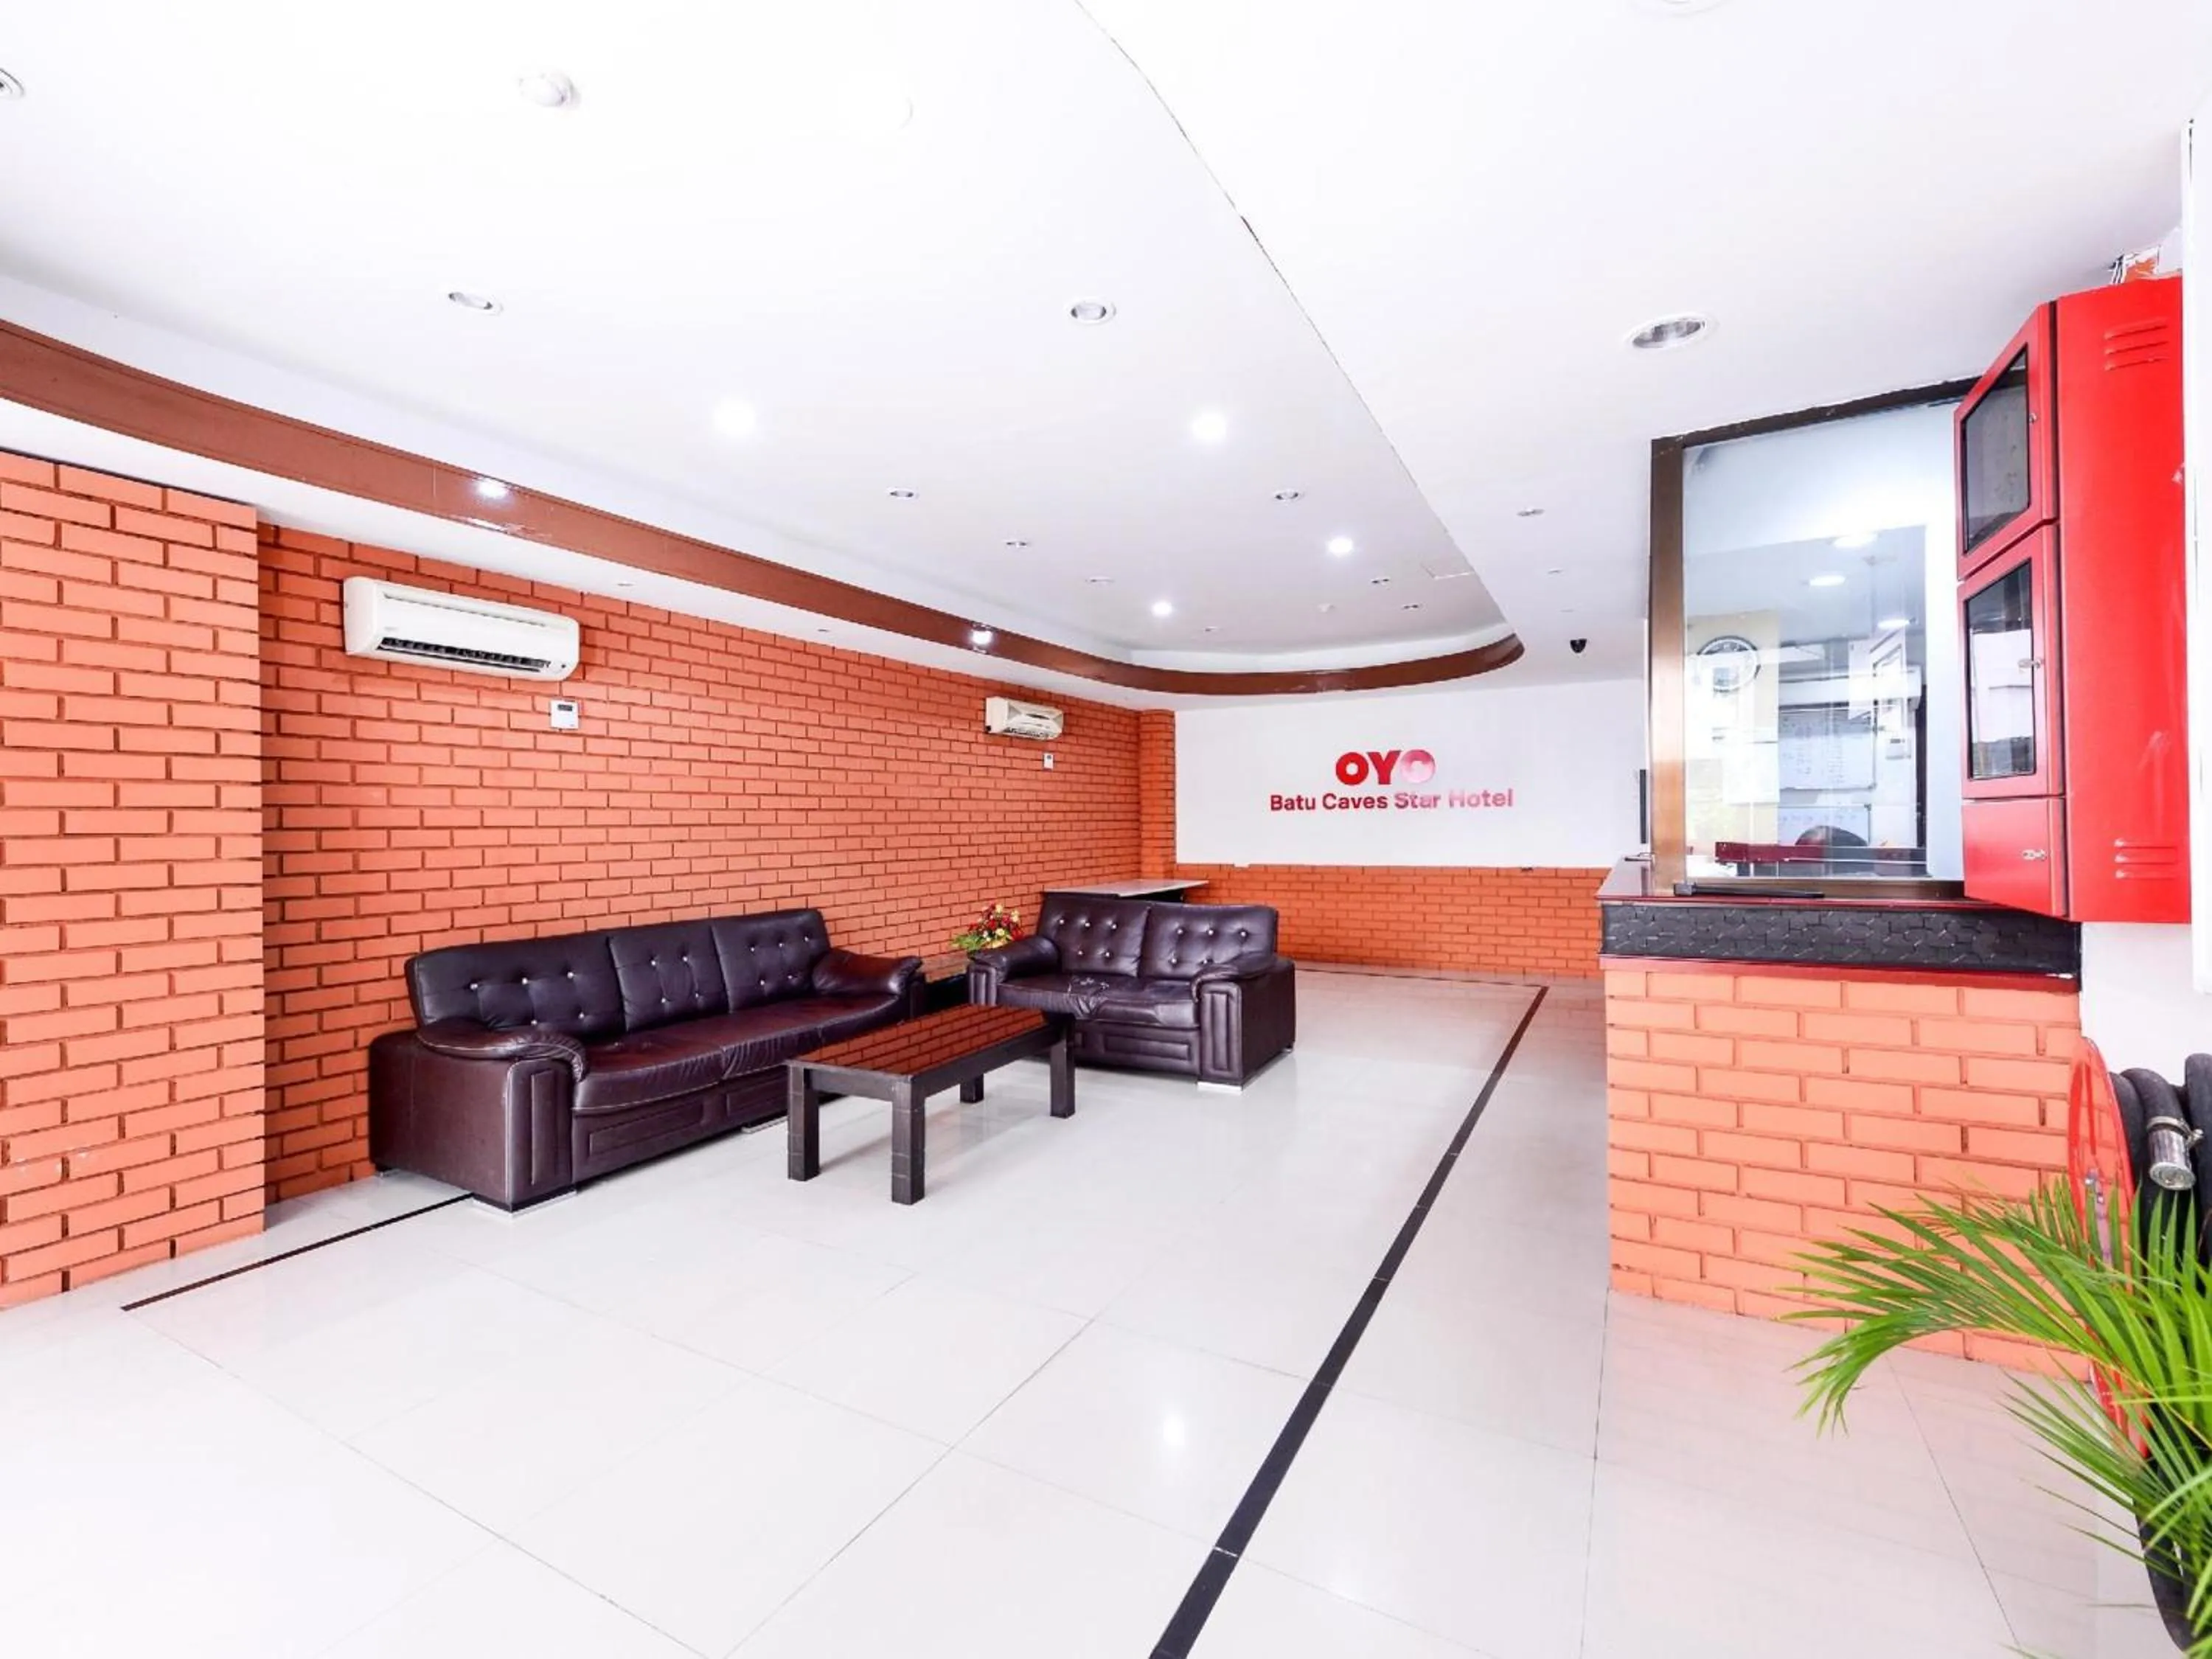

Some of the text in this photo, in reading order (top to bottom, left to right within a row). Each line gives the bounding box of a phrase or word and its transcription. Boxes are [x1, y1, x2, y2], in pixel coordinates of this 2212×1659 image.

[1335, 748, 1436, 786] OYO
[1270, 789, 1513, 811] Batu Caves Star Hotel
